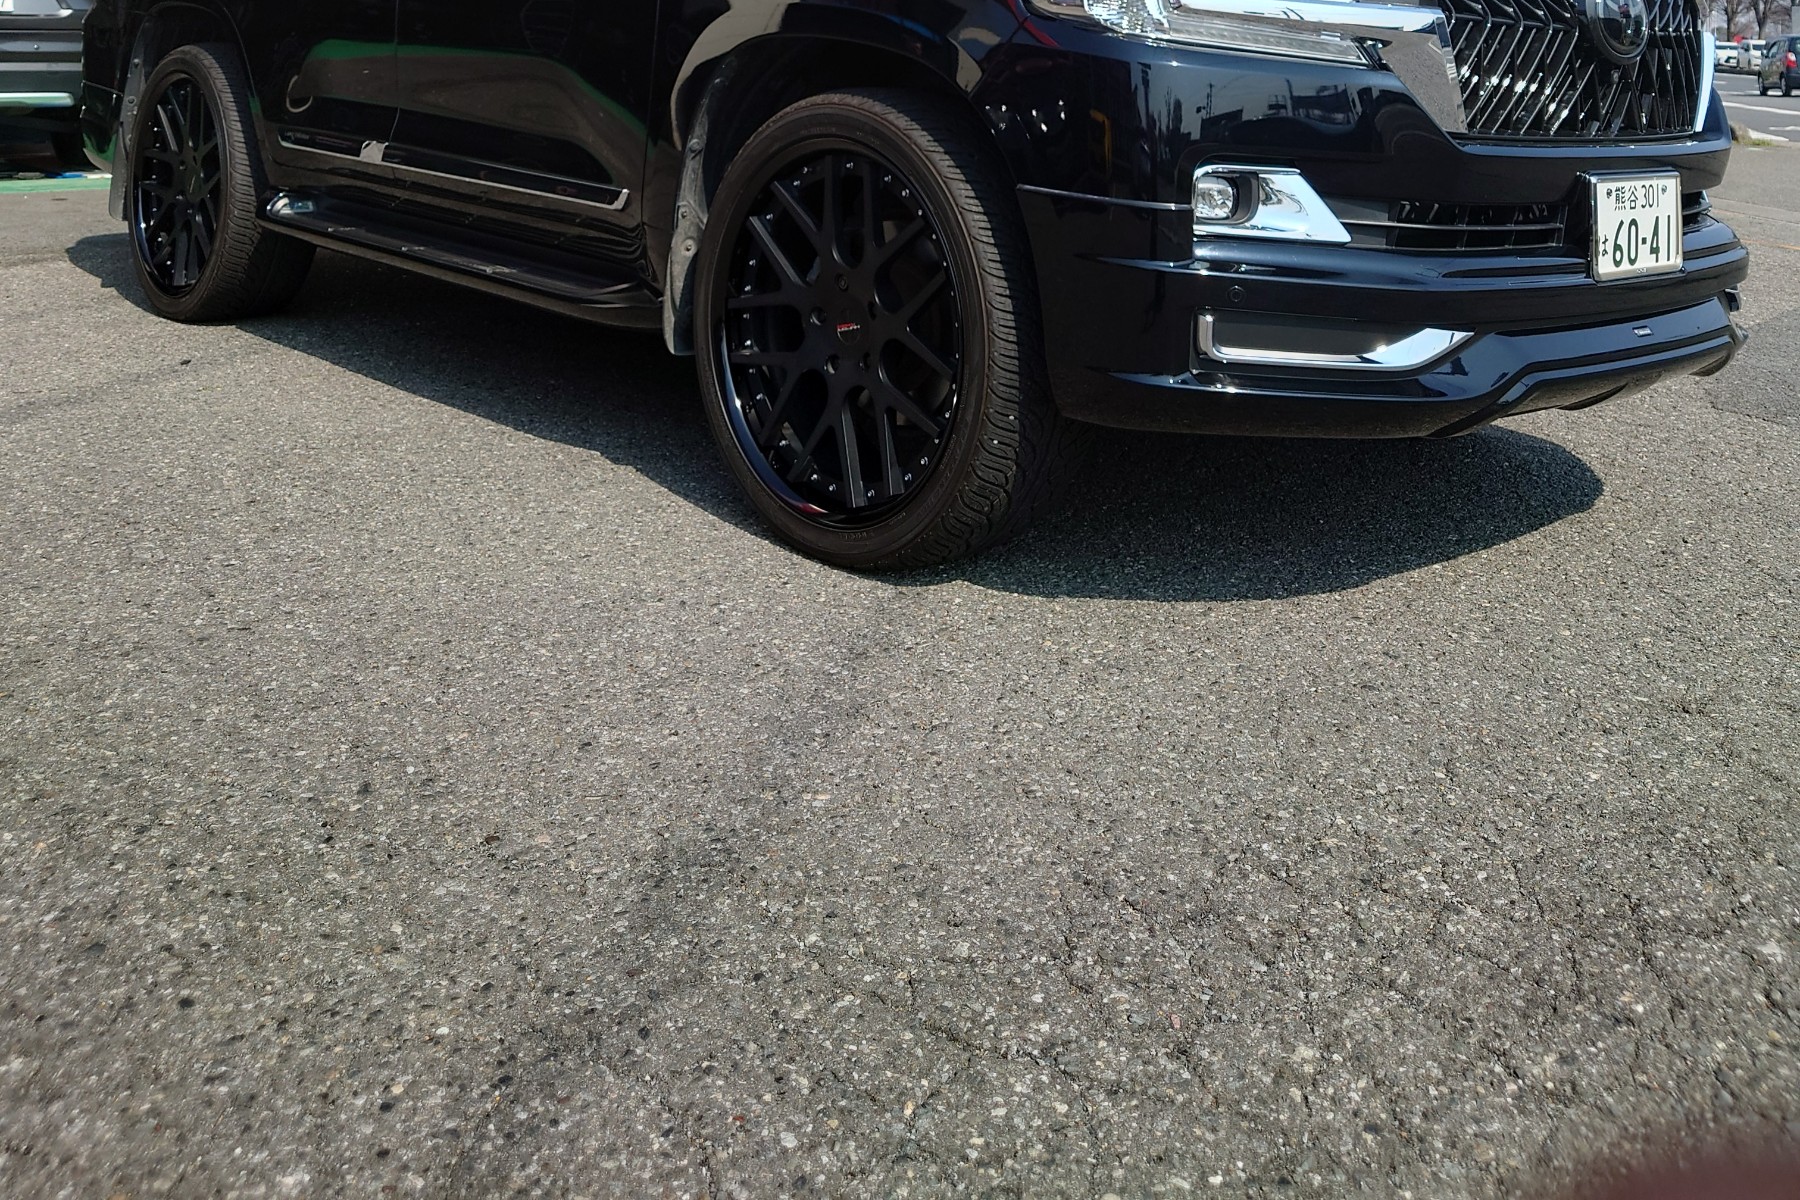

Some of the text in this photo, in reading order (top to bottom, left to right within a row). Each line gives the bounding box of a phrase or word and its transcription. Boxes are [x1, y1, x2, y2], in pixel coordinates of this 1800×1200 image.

[1614, 183, 1660, 211] 熊谷 301
[1612, 214, 1671, 268] 60-41
